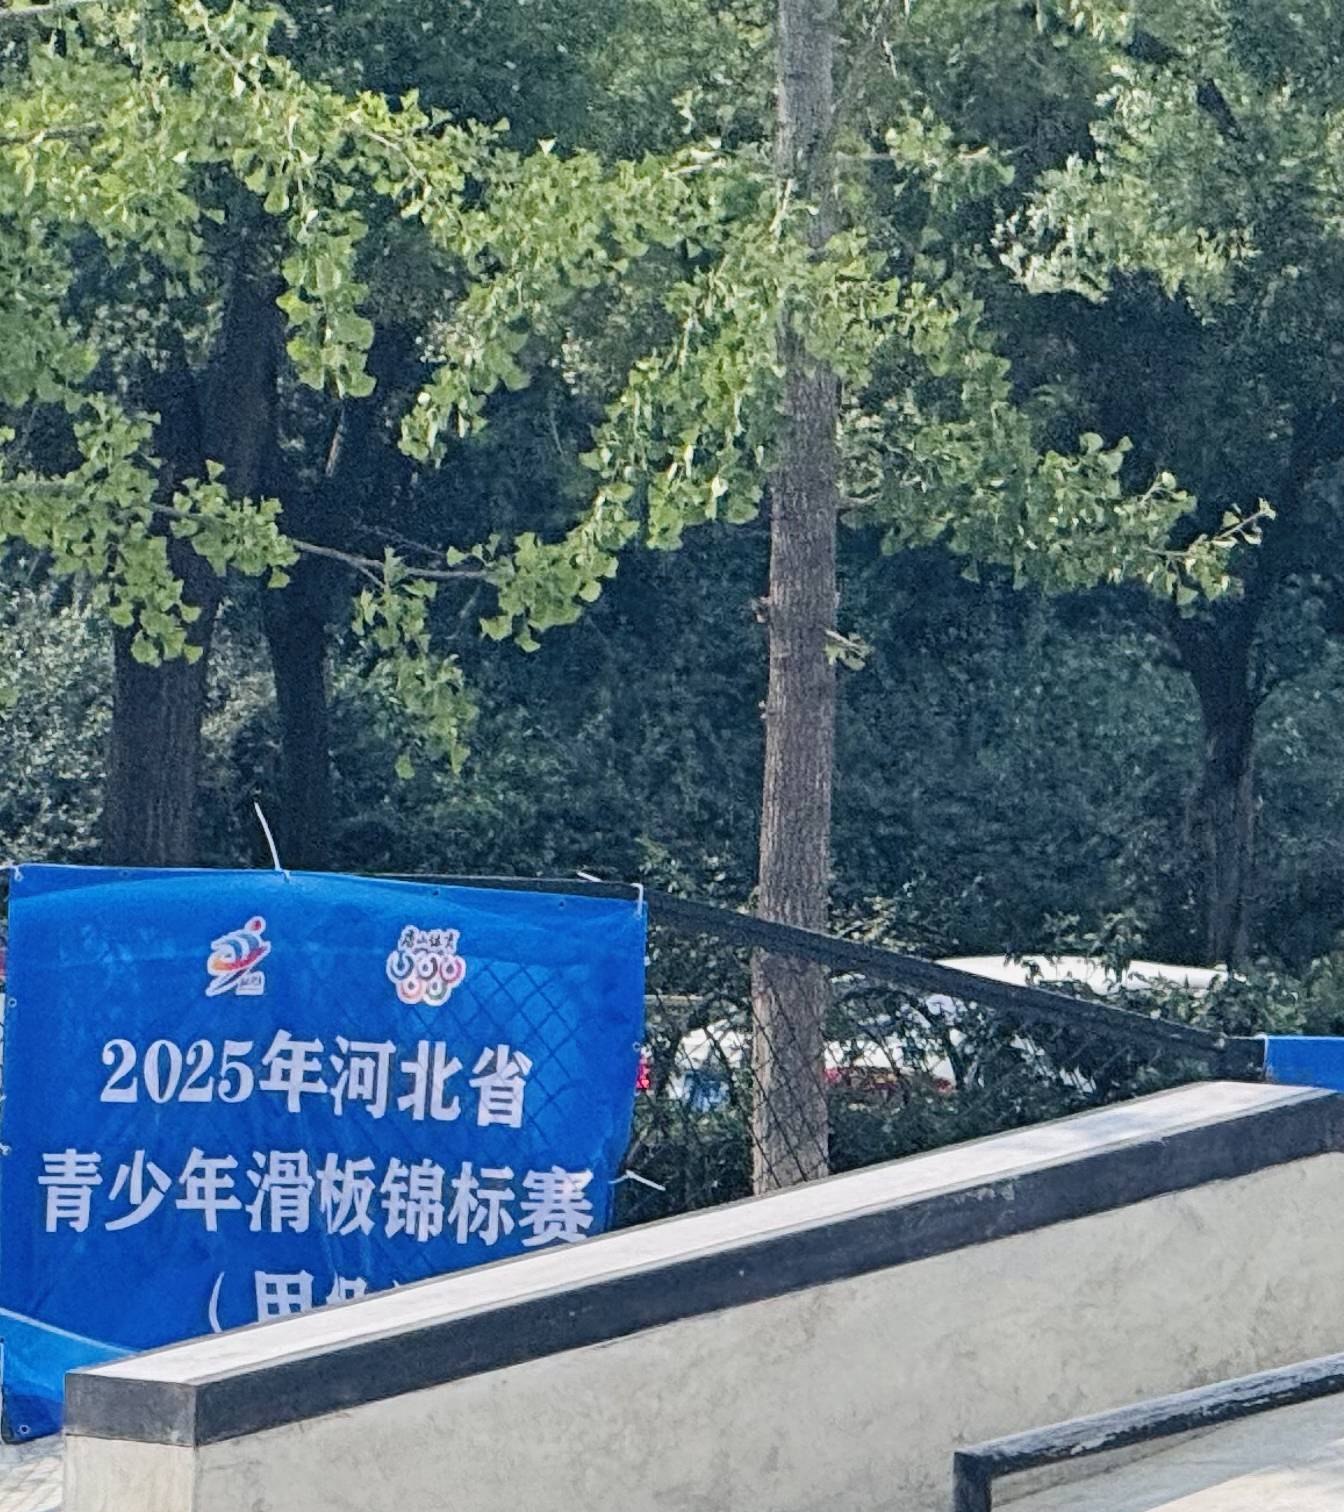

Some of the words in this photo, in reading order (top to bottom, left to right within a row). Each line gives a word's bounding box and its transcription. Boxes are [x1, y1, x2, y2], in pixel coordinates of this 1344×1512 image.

[100, 1030, 533, 1128] 2025年河北省
[38, 1148, 595, 1247] 青少年滑板锦标赛
